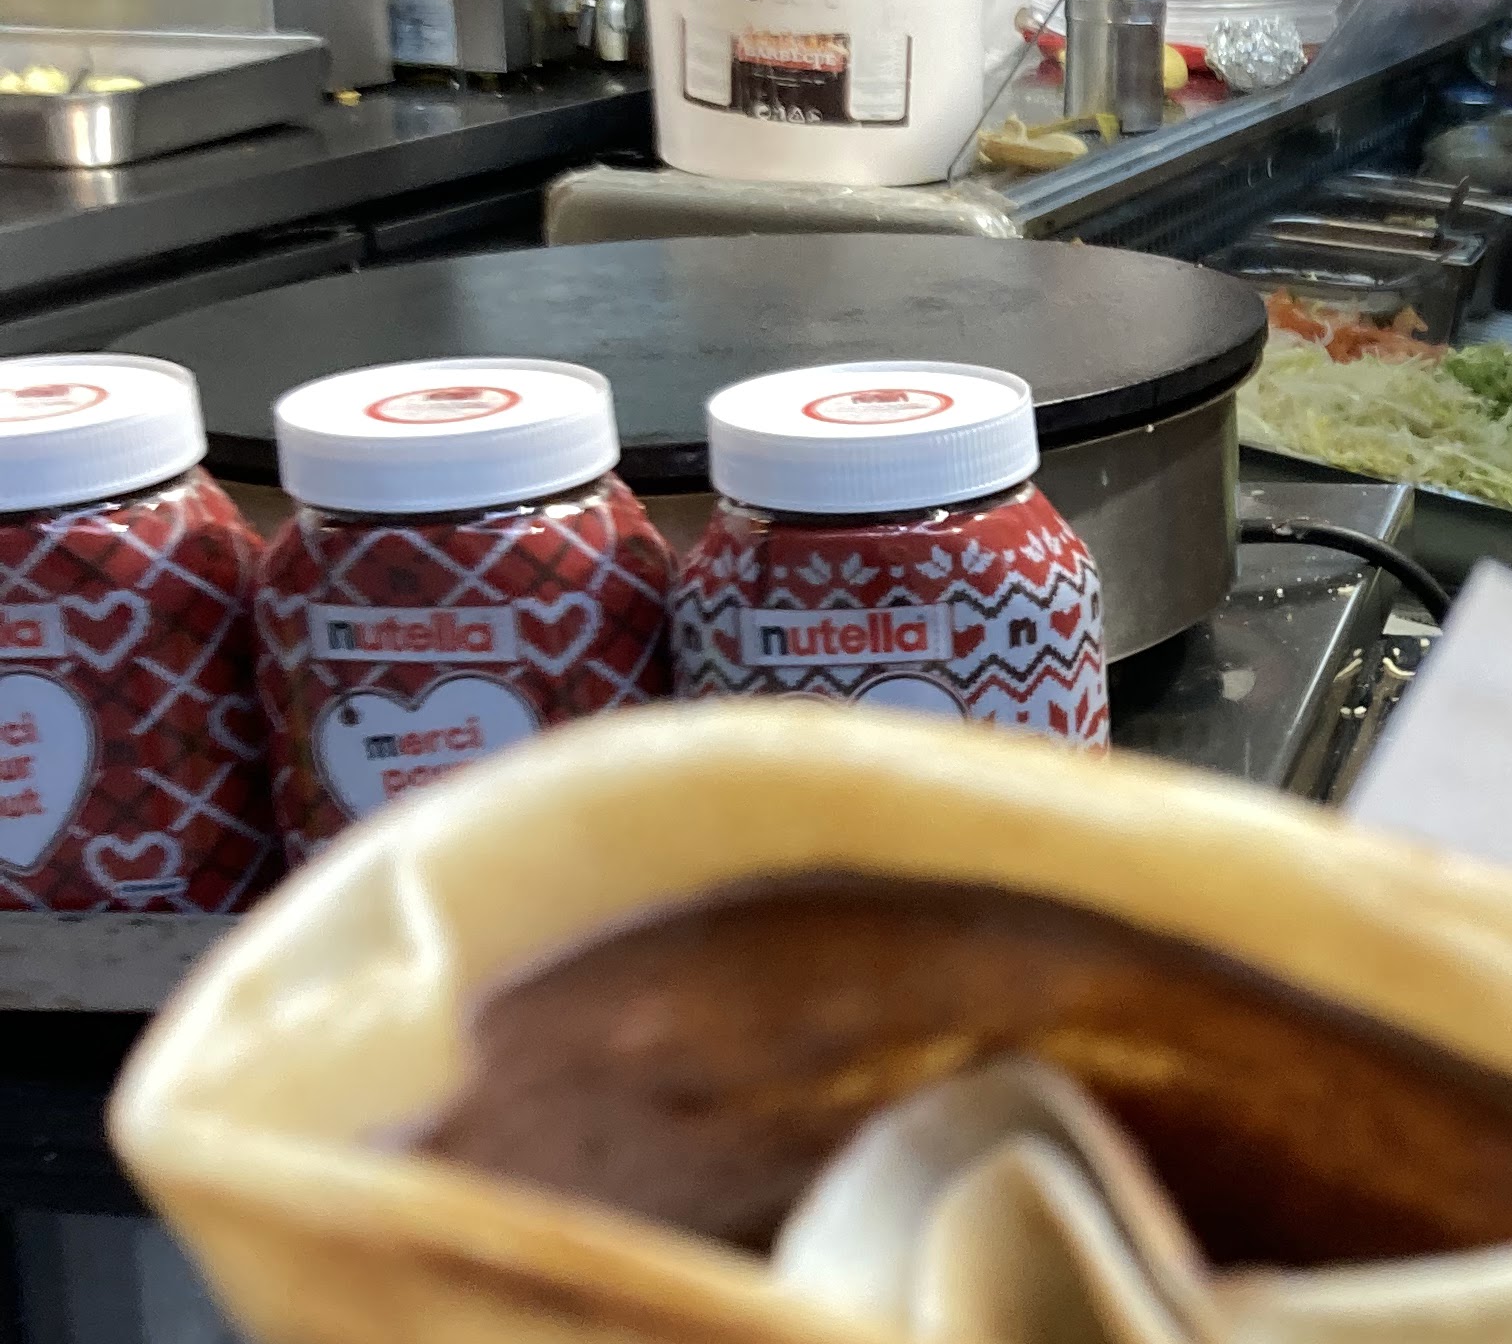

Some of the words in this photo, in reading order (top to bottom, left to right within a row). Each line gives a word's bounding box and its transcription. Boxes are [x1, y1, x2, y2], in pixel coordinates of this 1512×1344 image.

[327, 611, 494, 652] nutella
[761, 612, 928, 656] nutella
[362, 716, 484, 760] merci
